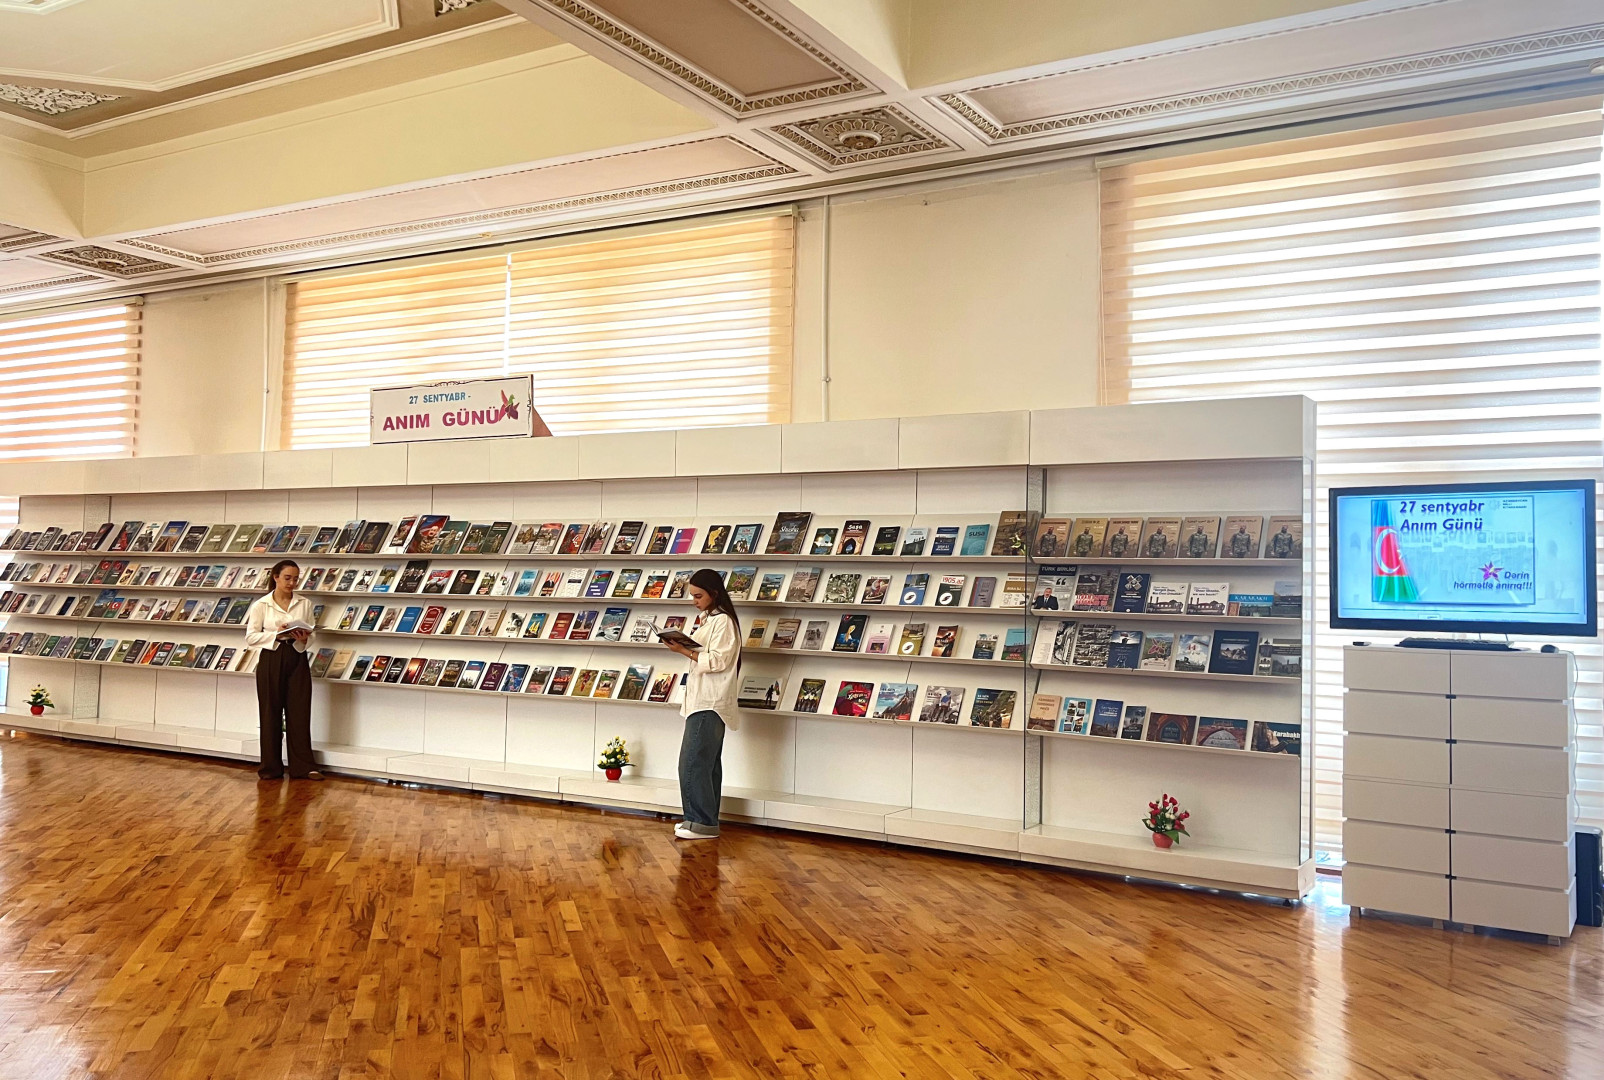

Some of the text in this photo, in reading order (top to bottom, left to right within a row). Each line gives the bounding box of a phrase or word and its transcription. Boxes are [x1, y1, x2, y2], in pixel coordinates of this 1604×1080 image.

[409, 395, 419, 405] 27
[423, 391, 466, 404] SENTYABR
[382, 406, 500, 431] ANIM GÜNÜ
[1399, 499, 1485, 515] 27 sentyabr
[1400, 517, 1483, 531] Anım Günü
